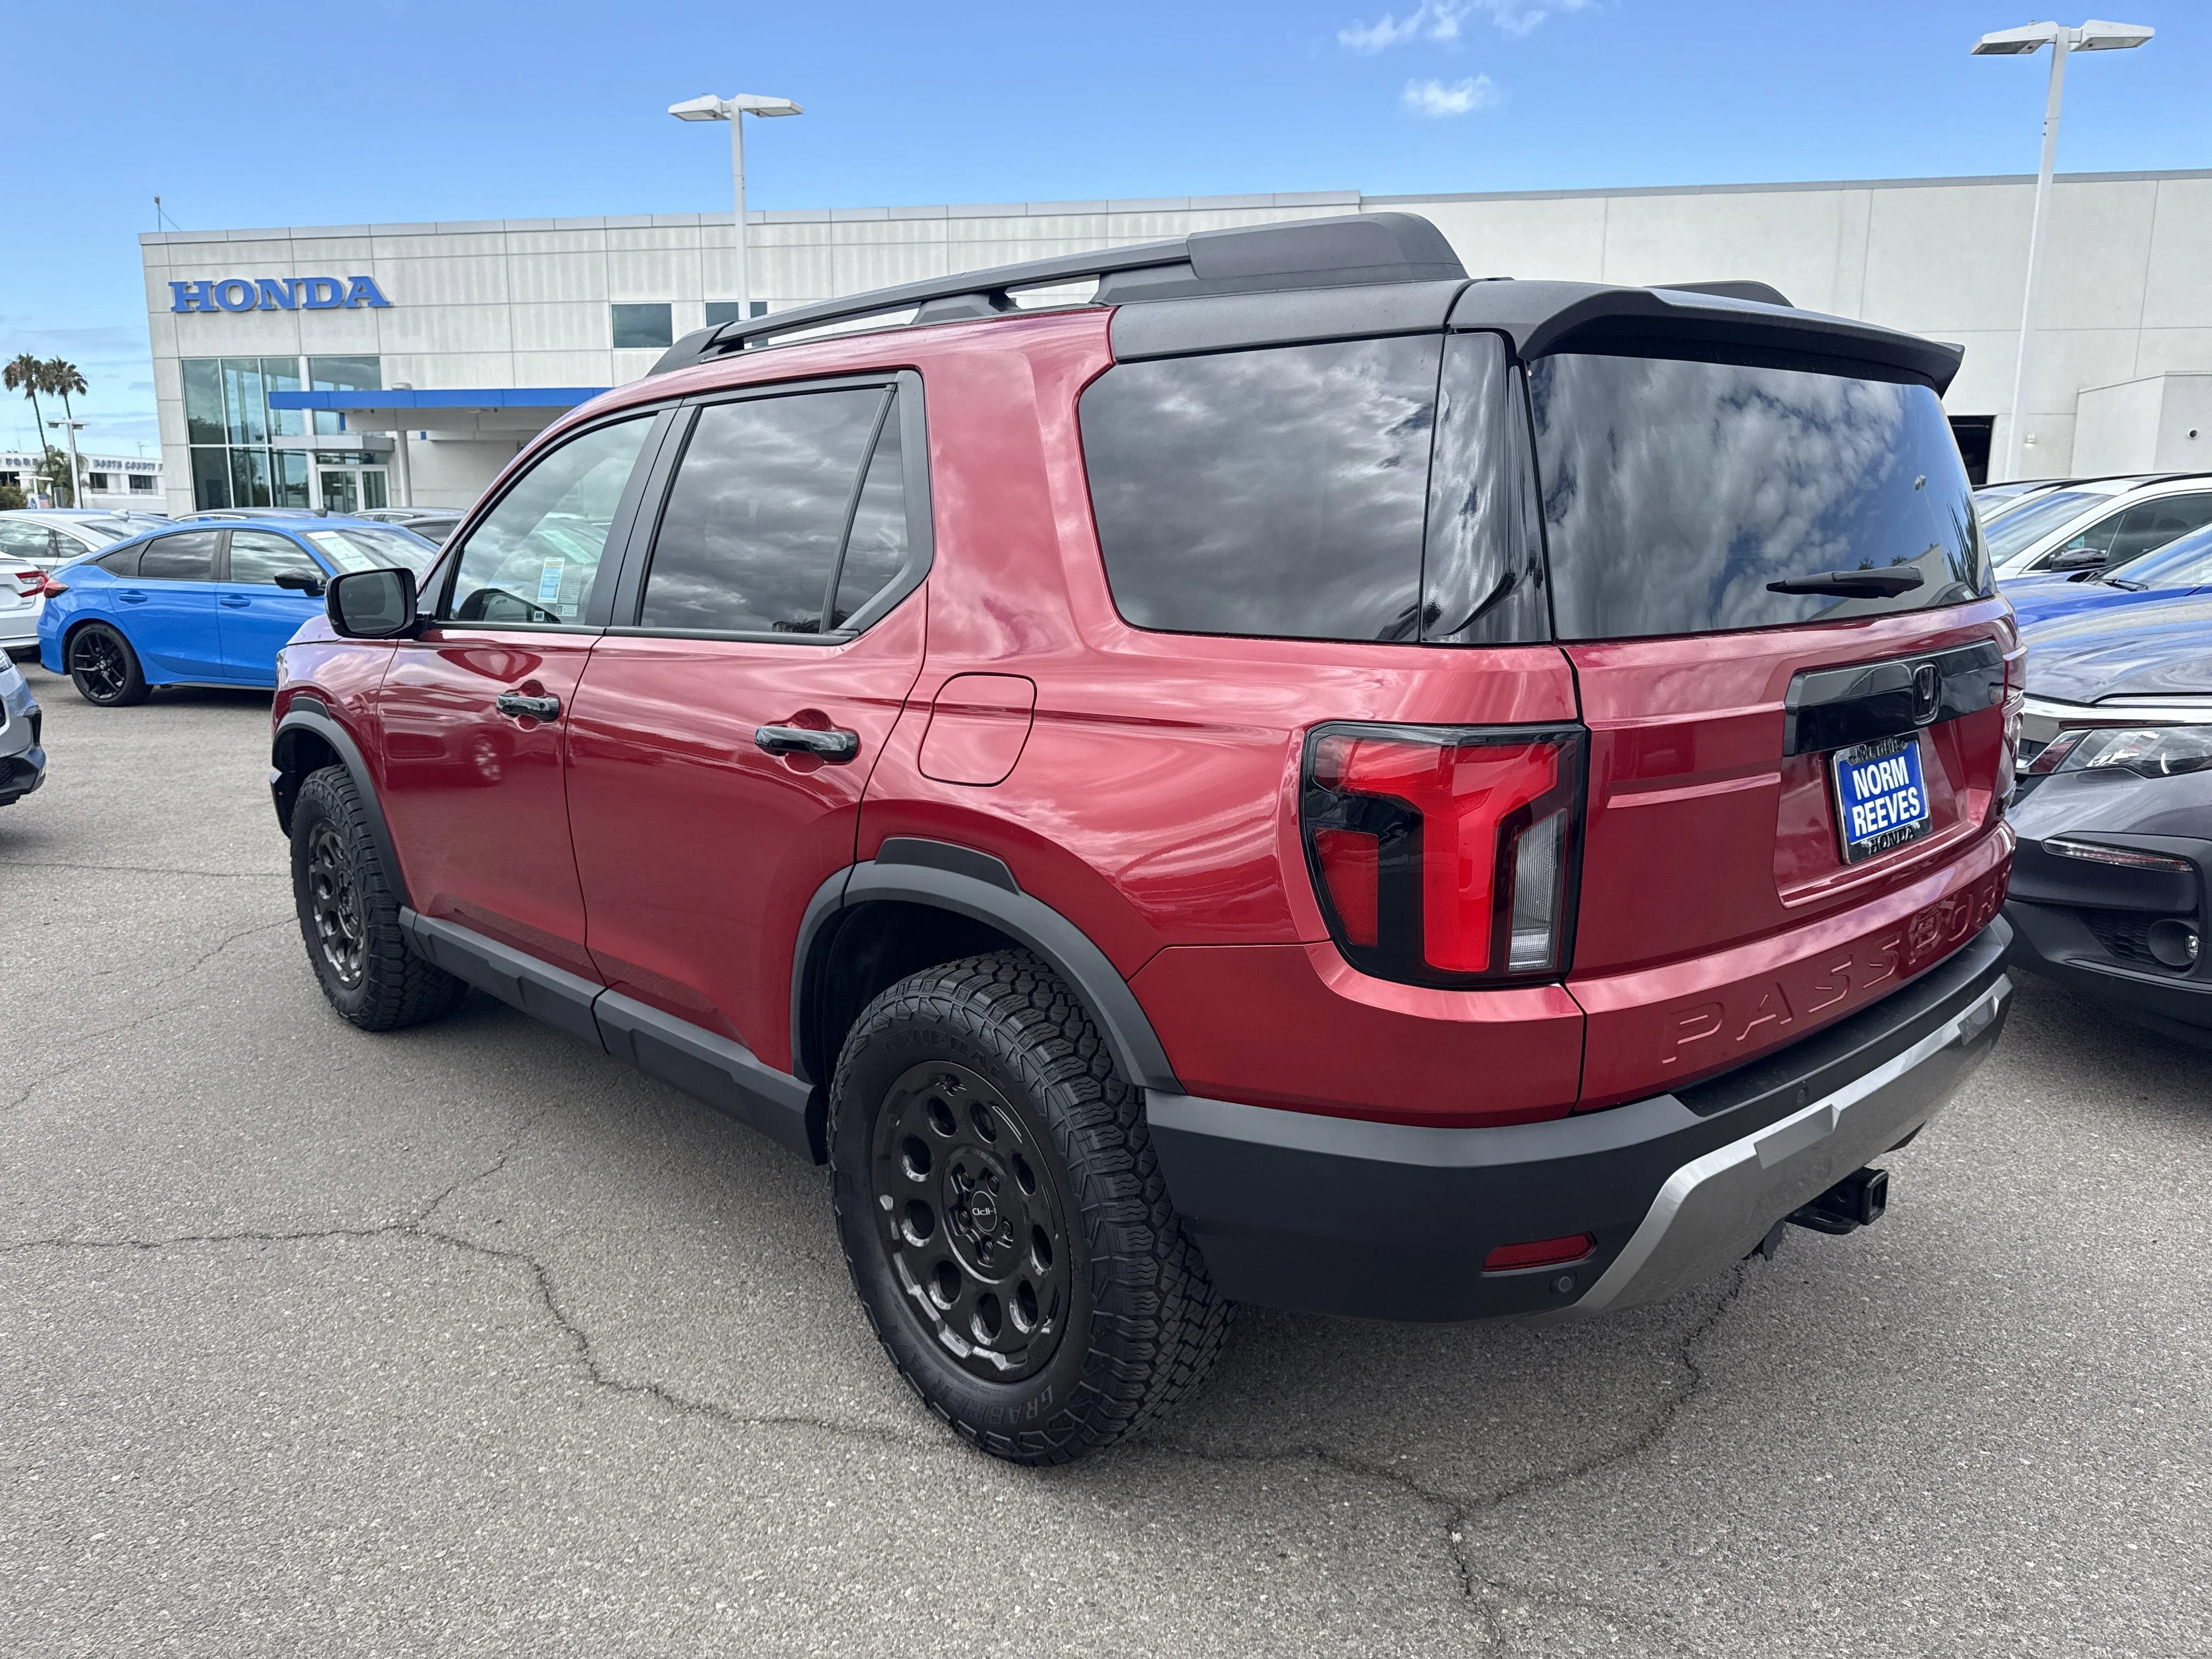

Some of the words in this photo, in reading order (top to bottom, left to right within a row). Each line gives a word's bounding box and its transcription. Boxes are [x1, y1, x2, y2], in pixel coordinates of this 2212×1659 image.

[168, 276, 392, 313] HONDA
[1852, 755, 1910, 800] NORM
[1852, 786, 1921, 837] REEVES
[1868, 825, 1915, 856] HONDA
[971, 1206, 997, 1217] HPD
[930, 1377, 1054, 1426] GRABBER
